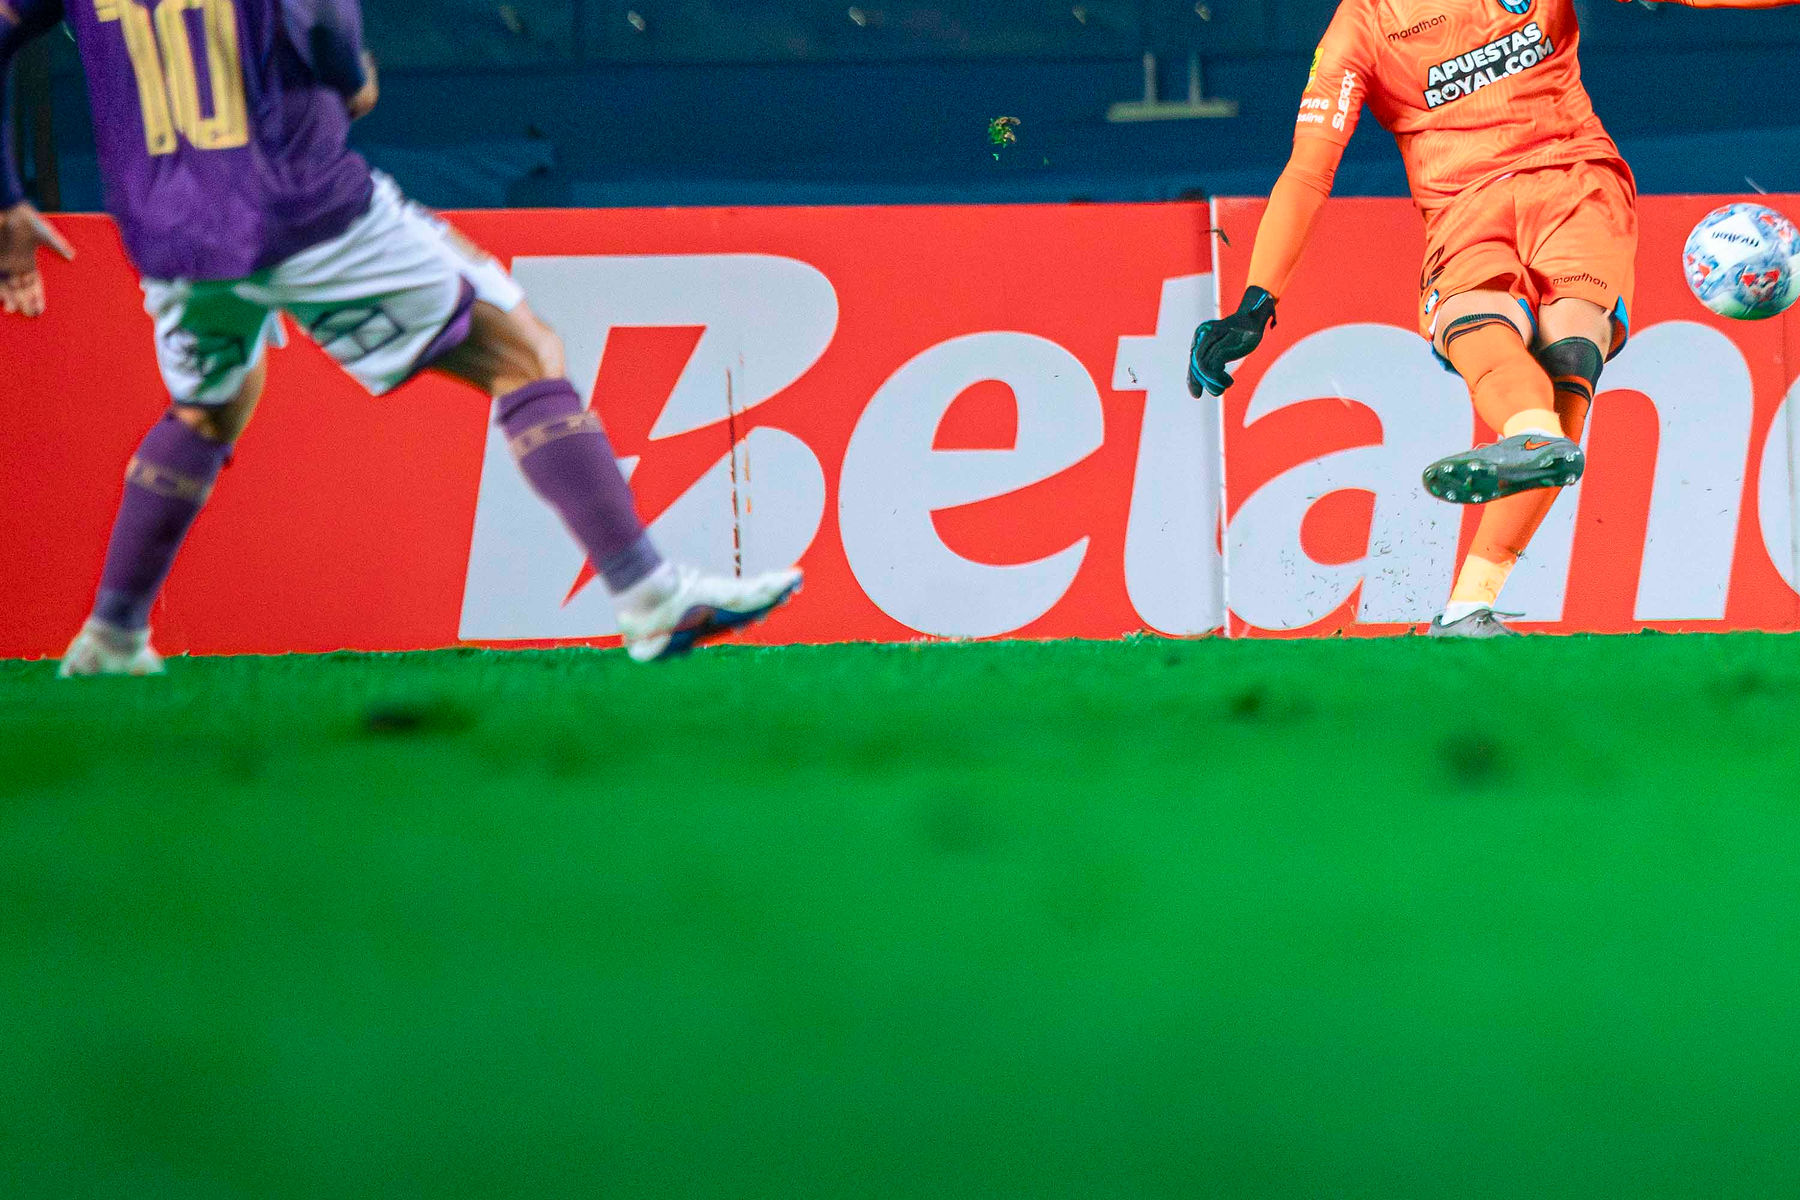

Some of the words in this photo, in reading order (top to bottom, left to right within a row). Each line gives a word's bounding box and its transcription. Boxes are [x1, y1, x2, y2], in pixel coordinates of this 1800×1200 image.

[1387, 14, 1447, 42] marathon
[1425, 38, 1554, 108] ROYAL.COM
[1428, 22, 1542, 87] APUESTAS
[1552, 272, 1608, 290] marathon
